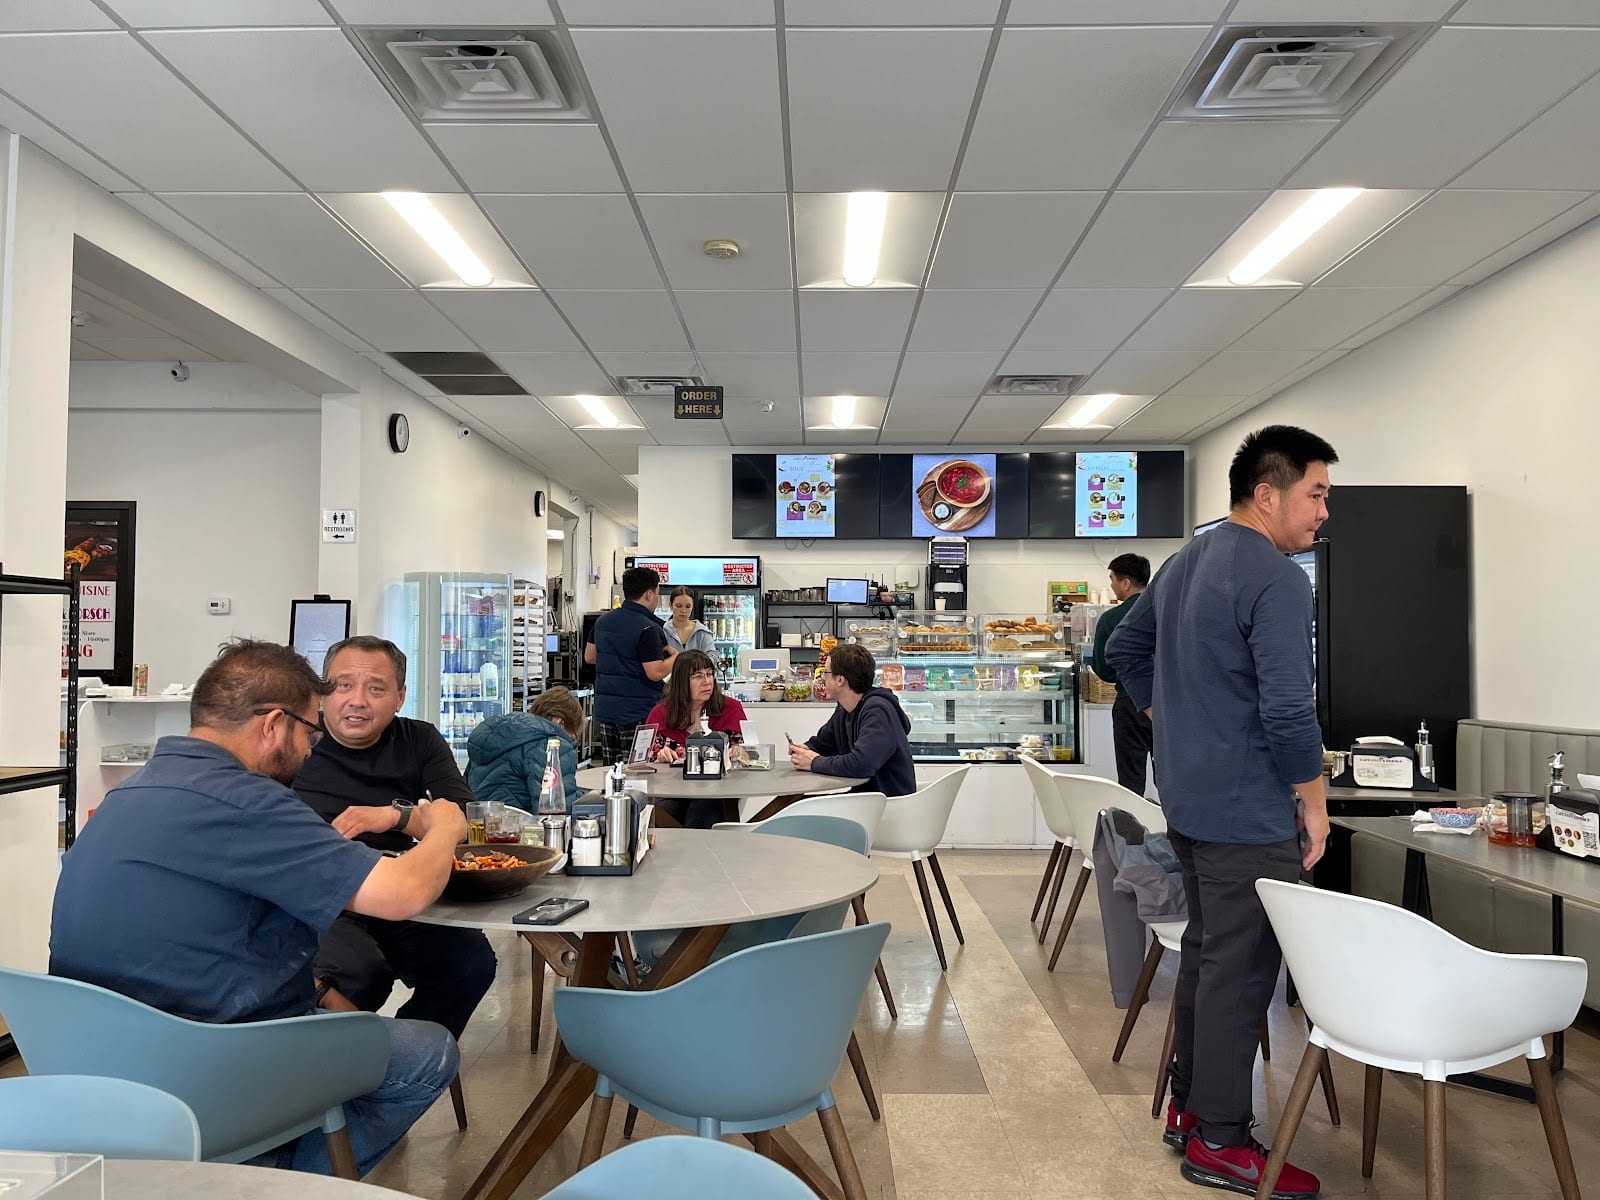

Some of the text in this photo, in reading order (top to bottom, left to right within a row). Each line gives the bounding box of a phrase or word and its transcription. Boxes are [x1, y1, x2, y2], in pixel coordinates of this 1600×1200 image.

[681, 391, 717, 401] ORDER
[684, 404, 713, 414] HERE
[79, 585, 112, 596] ISINE
[77, 608, 111, 620] ORSCH
